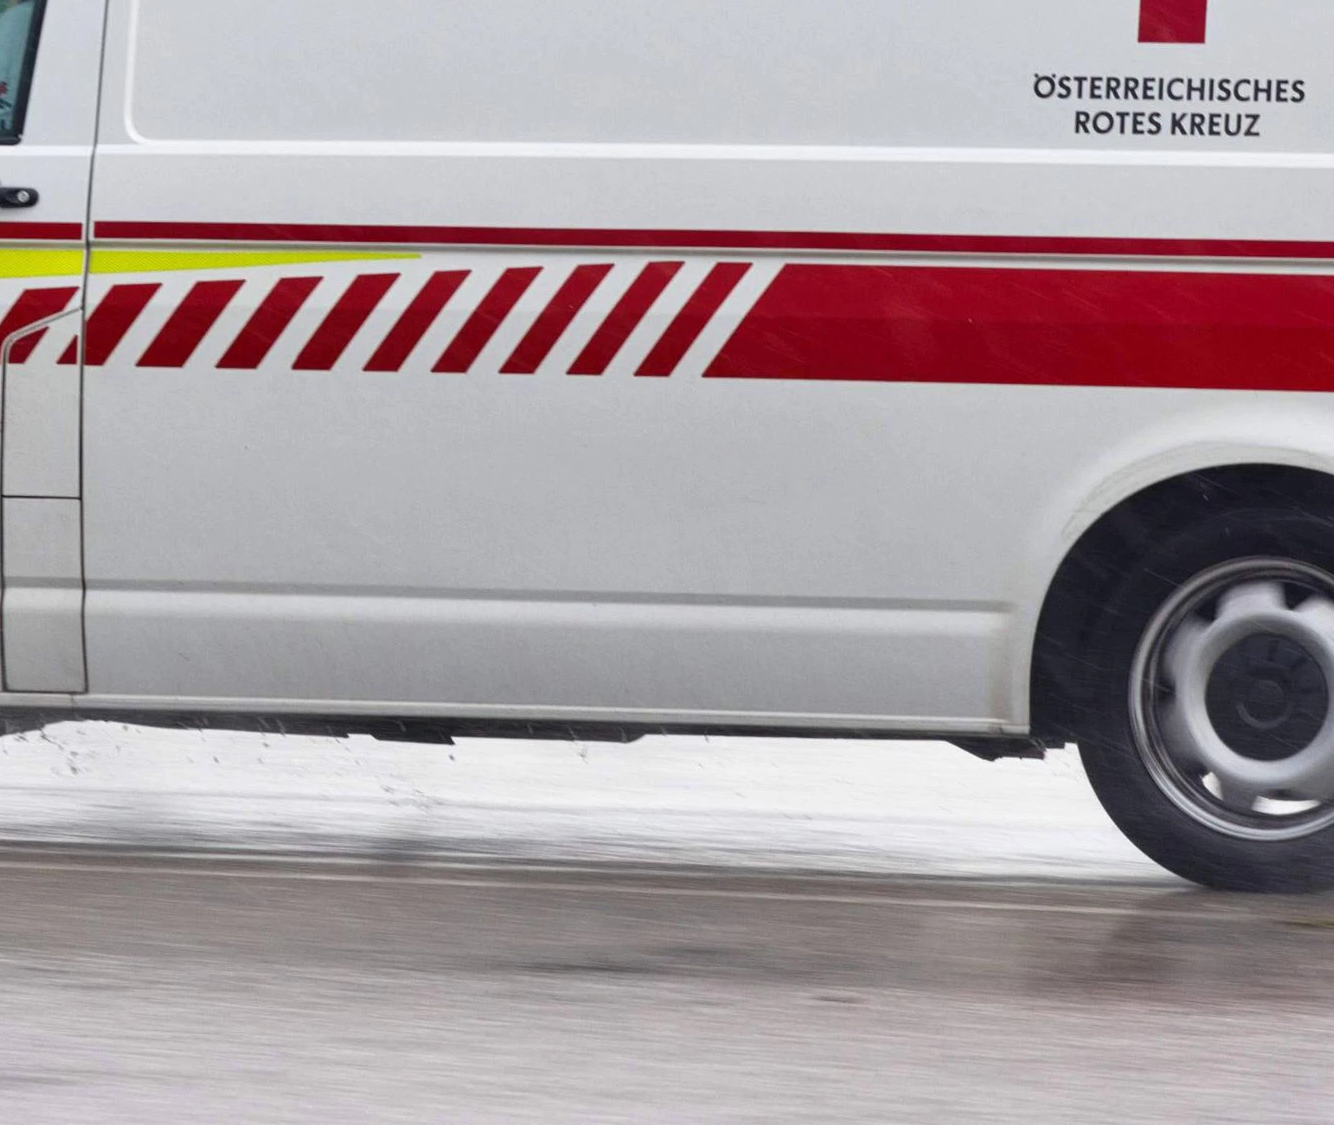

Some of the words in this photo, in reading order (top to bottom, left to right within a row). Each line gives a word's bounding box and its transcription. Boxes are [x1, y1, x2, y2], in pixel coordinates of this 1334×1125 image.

[1033, 73, 1306, 102] ÖSTERREICHISCHES
[1074, 111, 1162, 135] ROTES
[1170, 112, 1261, 136] KREUZ
